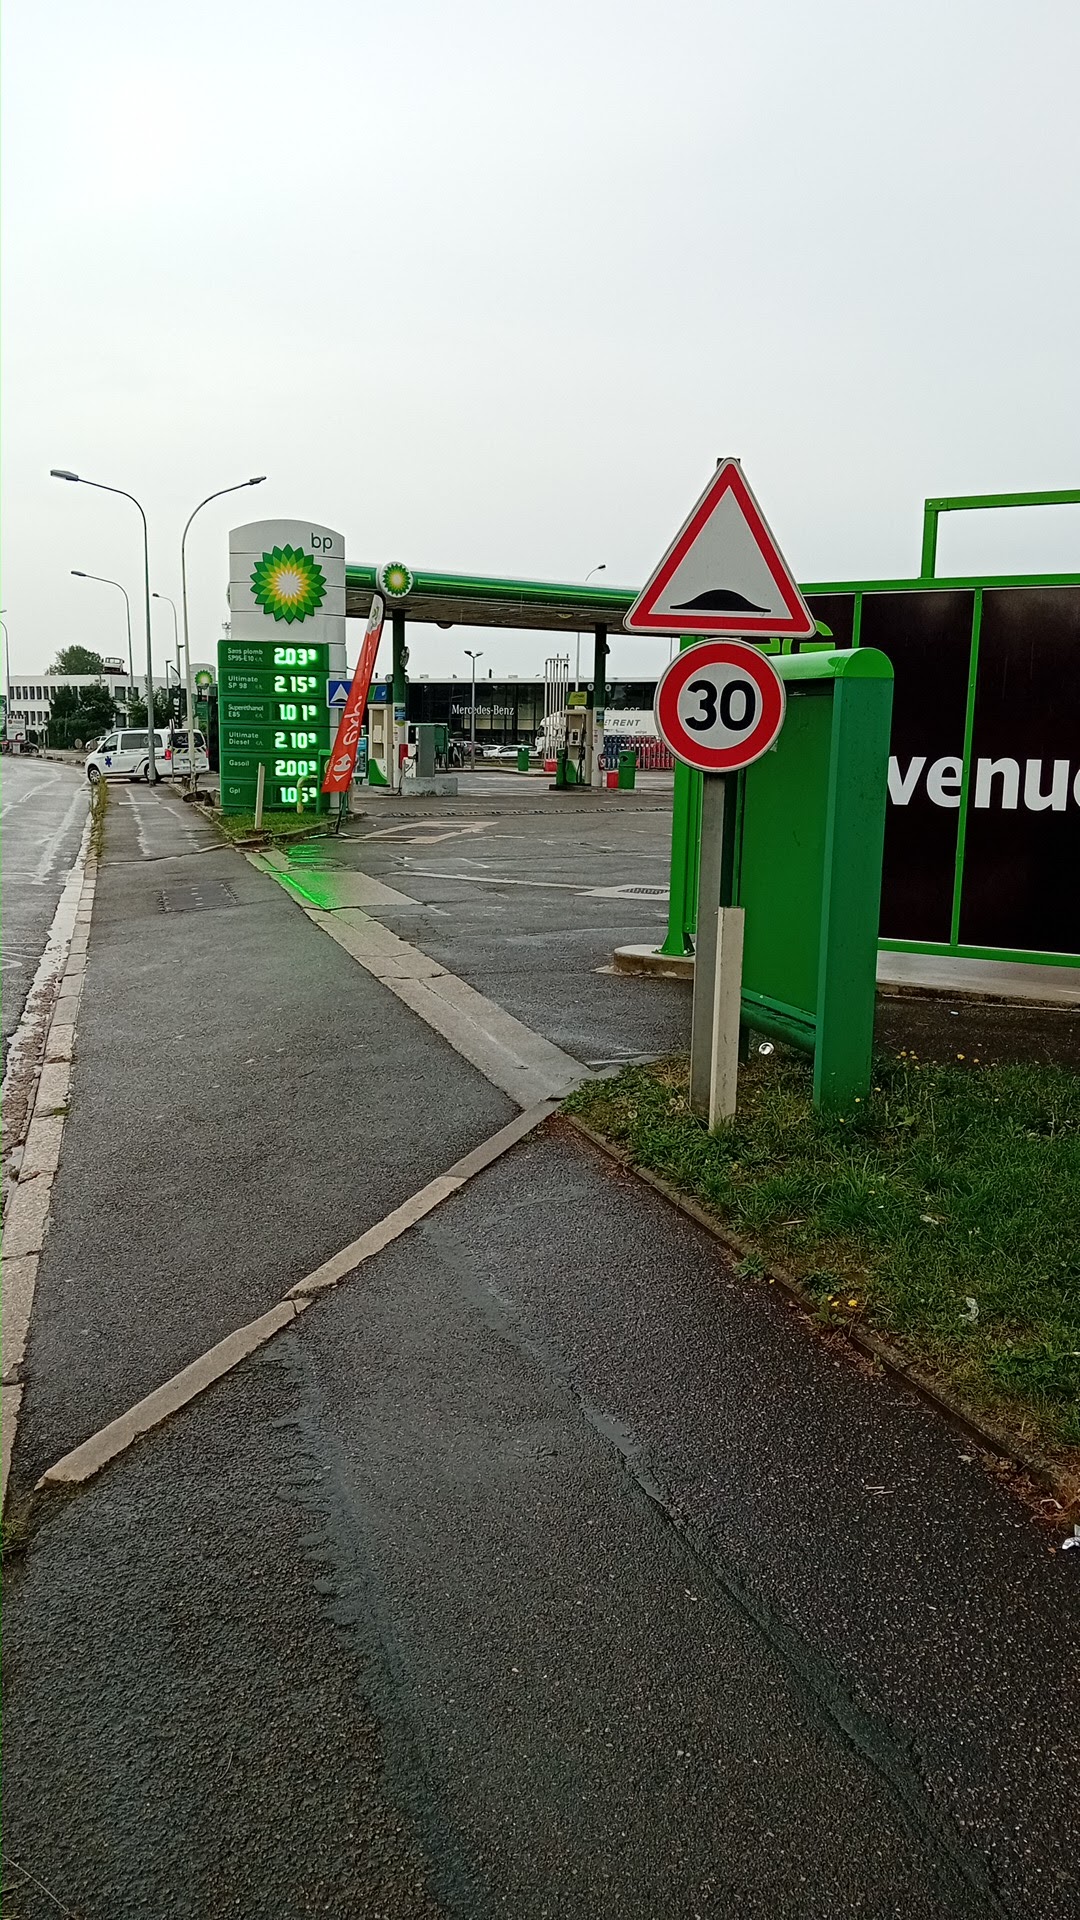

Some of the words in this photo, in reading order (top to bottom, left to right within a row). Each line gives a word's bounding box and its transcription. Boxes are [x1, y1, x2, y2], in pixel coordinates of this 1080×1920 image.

[311, 532, 333, 553] bp
[228, 675, 259, 683] Ultimate
[228, 704, 264, 712] Superethanol
[451, 704, 515, 715] Mercedes-Benz
[685, 680, 756, 731] 30
[229, 731, 259, 739] Ultimate
[887, 755, 1080, 811] venu
